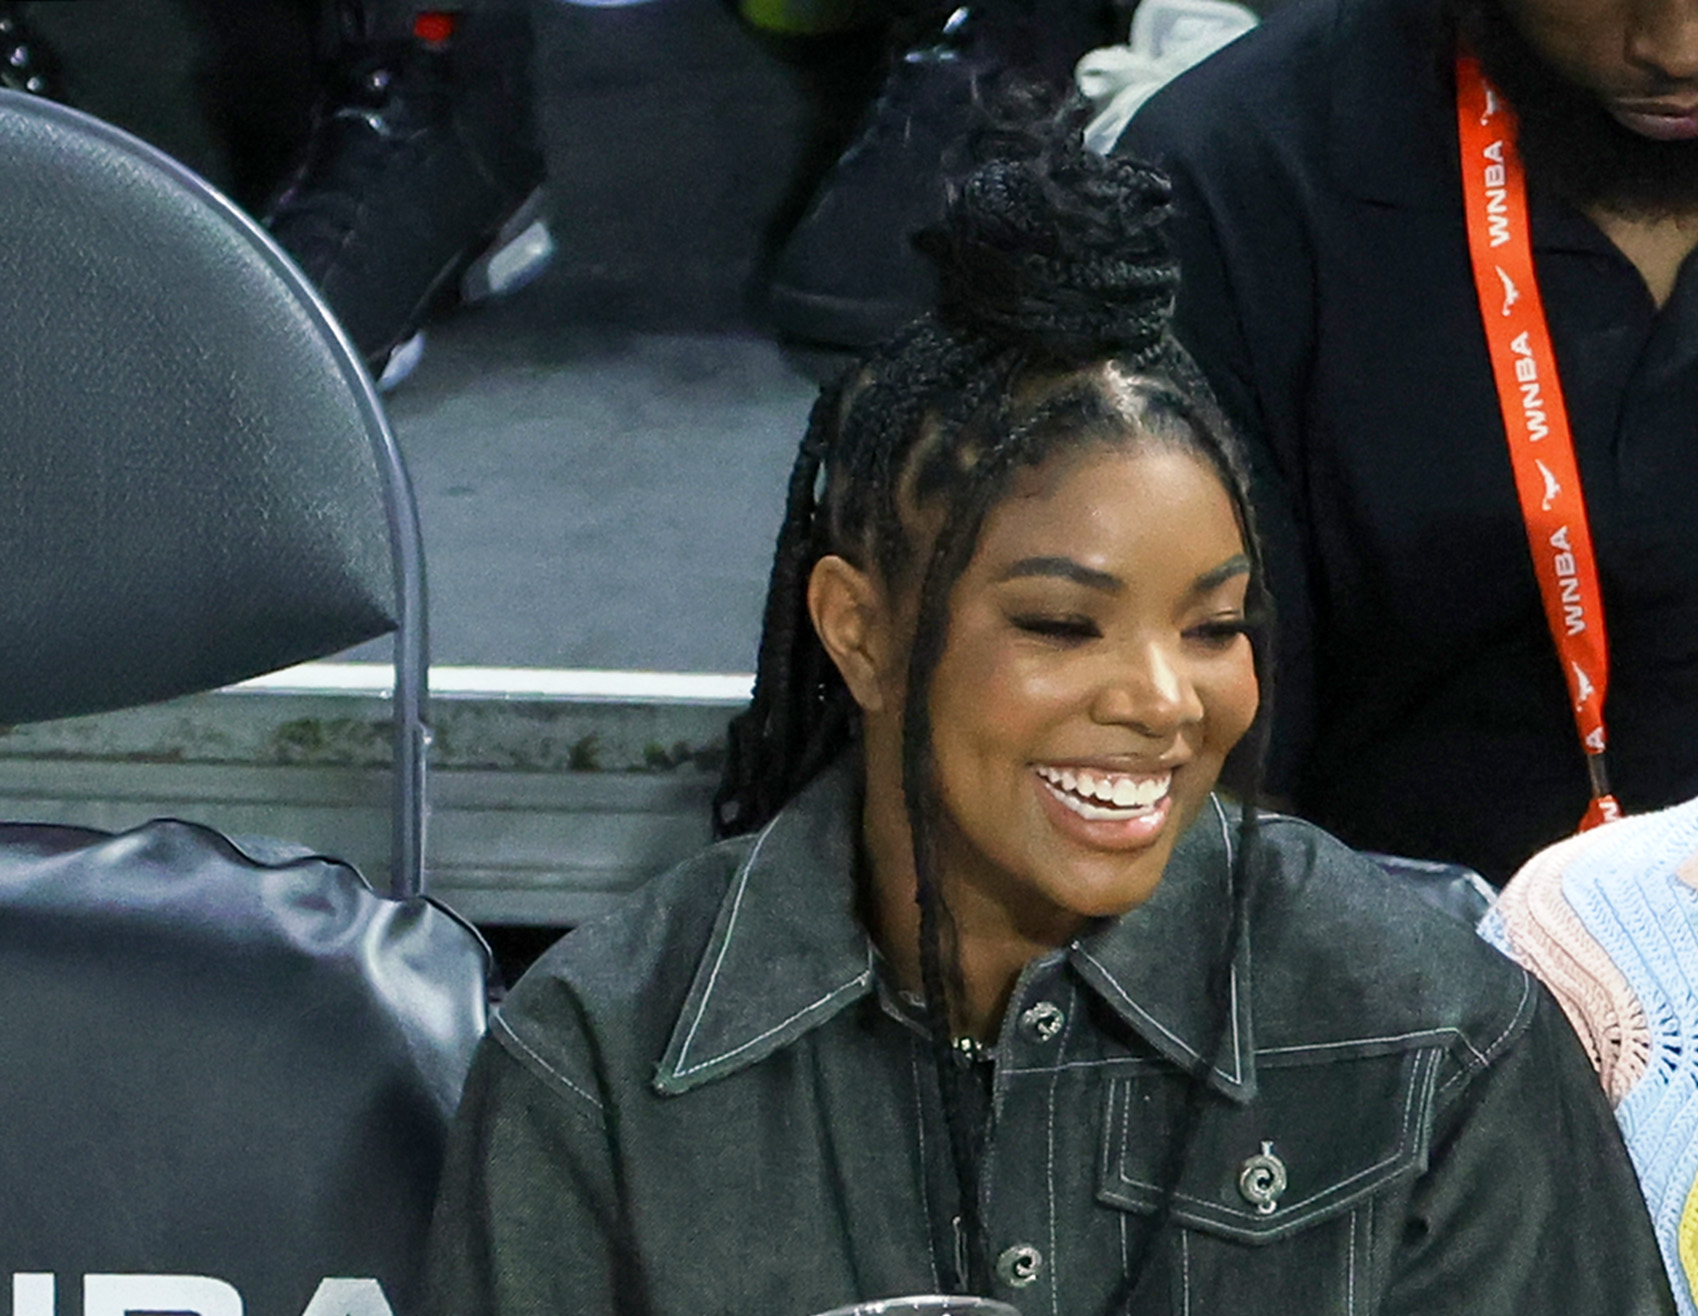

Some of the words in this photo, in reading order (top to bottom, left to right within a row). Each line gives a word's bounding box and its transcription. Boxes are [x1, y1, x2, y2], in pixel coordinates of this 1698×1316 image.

[1484, 140, 1510, 248] WNBA
[1510, 331, 1549, 442] WNBA
[1550, 525, 1586, 636] WNBA
